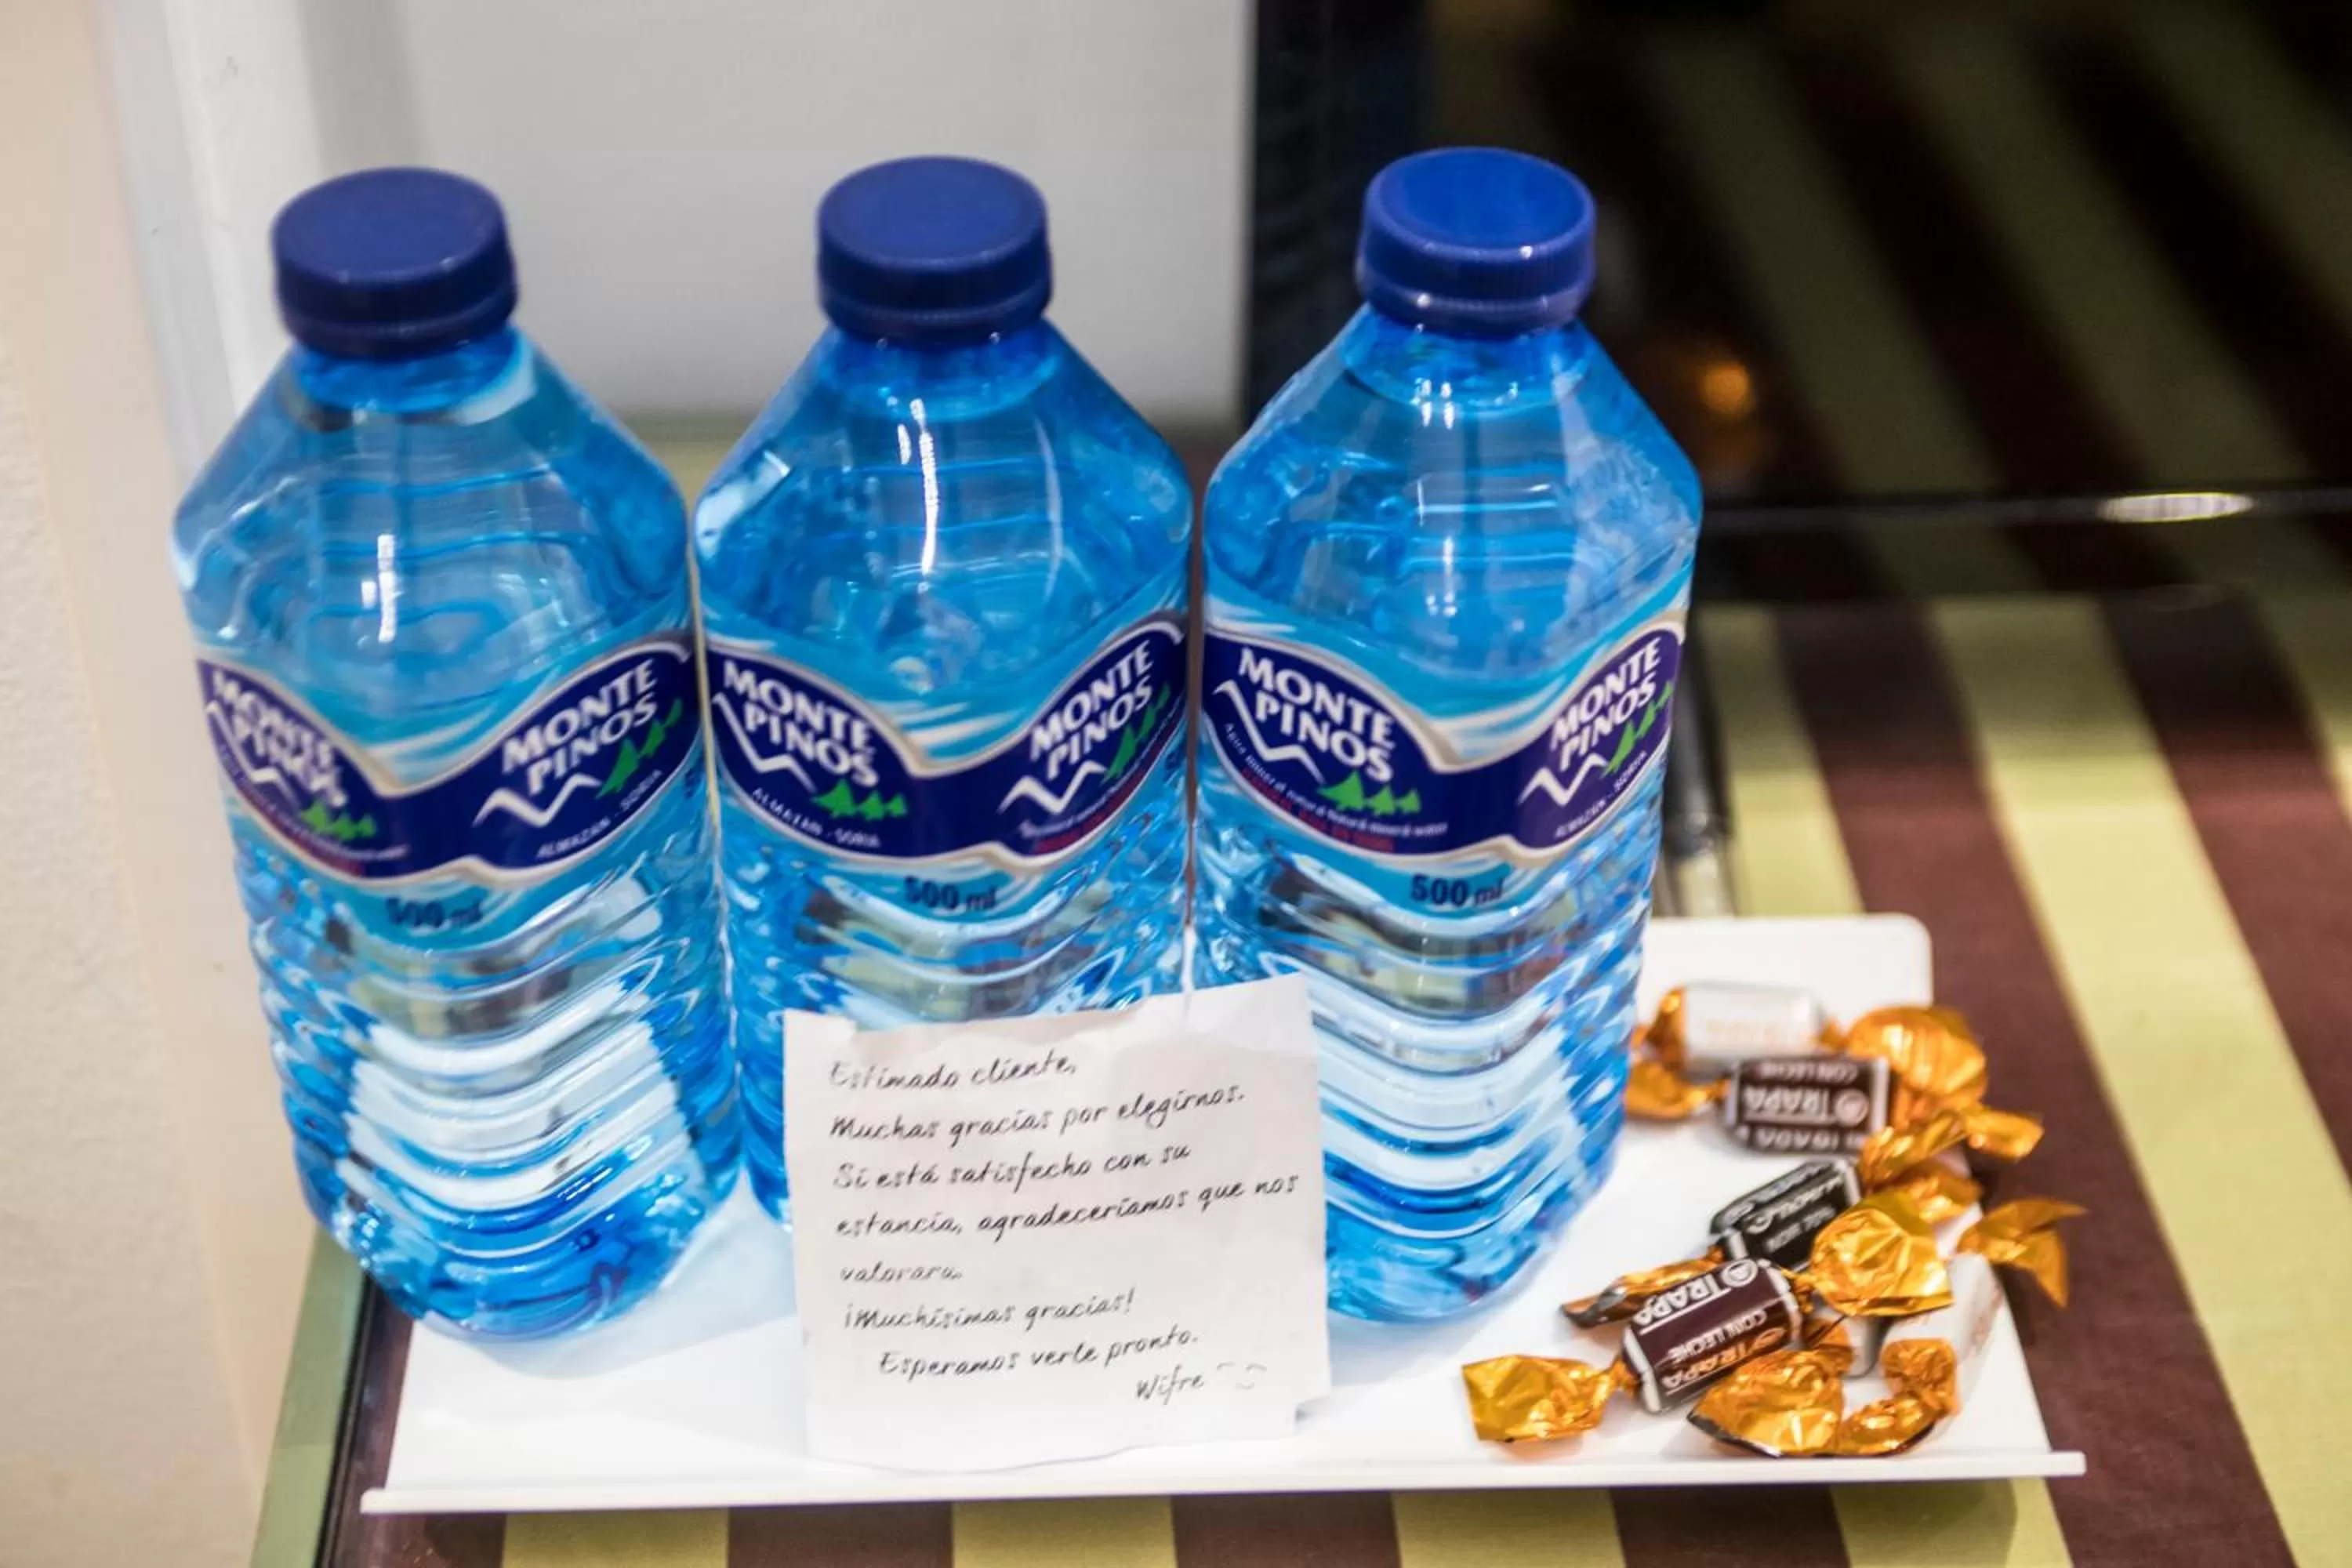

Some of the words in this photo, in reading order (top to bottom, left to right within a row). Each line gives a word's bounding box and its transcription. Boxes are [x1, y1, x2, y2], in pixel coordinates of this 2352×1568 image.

[502, 658, 658, 775] MONTE
[724, 659, 875, 754] MONTE
[1030, 639, 1153, 762] MONTE
[1047, 674, 1152, 781] PINOS
[1238, 646, 1396, 750] MONTE
[1549, 636, 1662, 752] MONTE
[1559, 670, 1657, 772] PINOS
[527, 691, 657, 797] PINOS
[744, 701, 879, 787] PINOS
[1254, 689, 1394, 782] PINOS
[904, 875, 960, 909] 500
[1410, 873, 1468, 906] 500
[1475, 878, 1504, 902] ml
[829, 1060, 960, 1090] Estimado
[971, 1048, 1076, 1085] cliente,
[1744, 1086, 1832, 1123] TRAPA
[830, 1114, 940, 1138] Muchas
[949, 1110, 1052, 1148] gracias
[1060, 1105, 1108, 1135] por
[1117, 1085, 1245, 1129] elegirnos.
[833, 1162, 869, 1189] Si
[876, 1160, 939, 1188] está
[949, 1150, 1091, 1194] satisfecho
[1103, 1153, 1151, 1172] con
[1161, 1143, 1191, 1163] su
[1199, 1182, 1245, 1212] que
[1254, 1175, 1299, 1194] nos
[1024, 1287, 1135, 1332] gracias!
[1632, 1272, 1726, 1327] TRAPA
[879, 1352, 1021, 1383] Esperamos
[1104, 1323, 1198, 1368] pronto.
